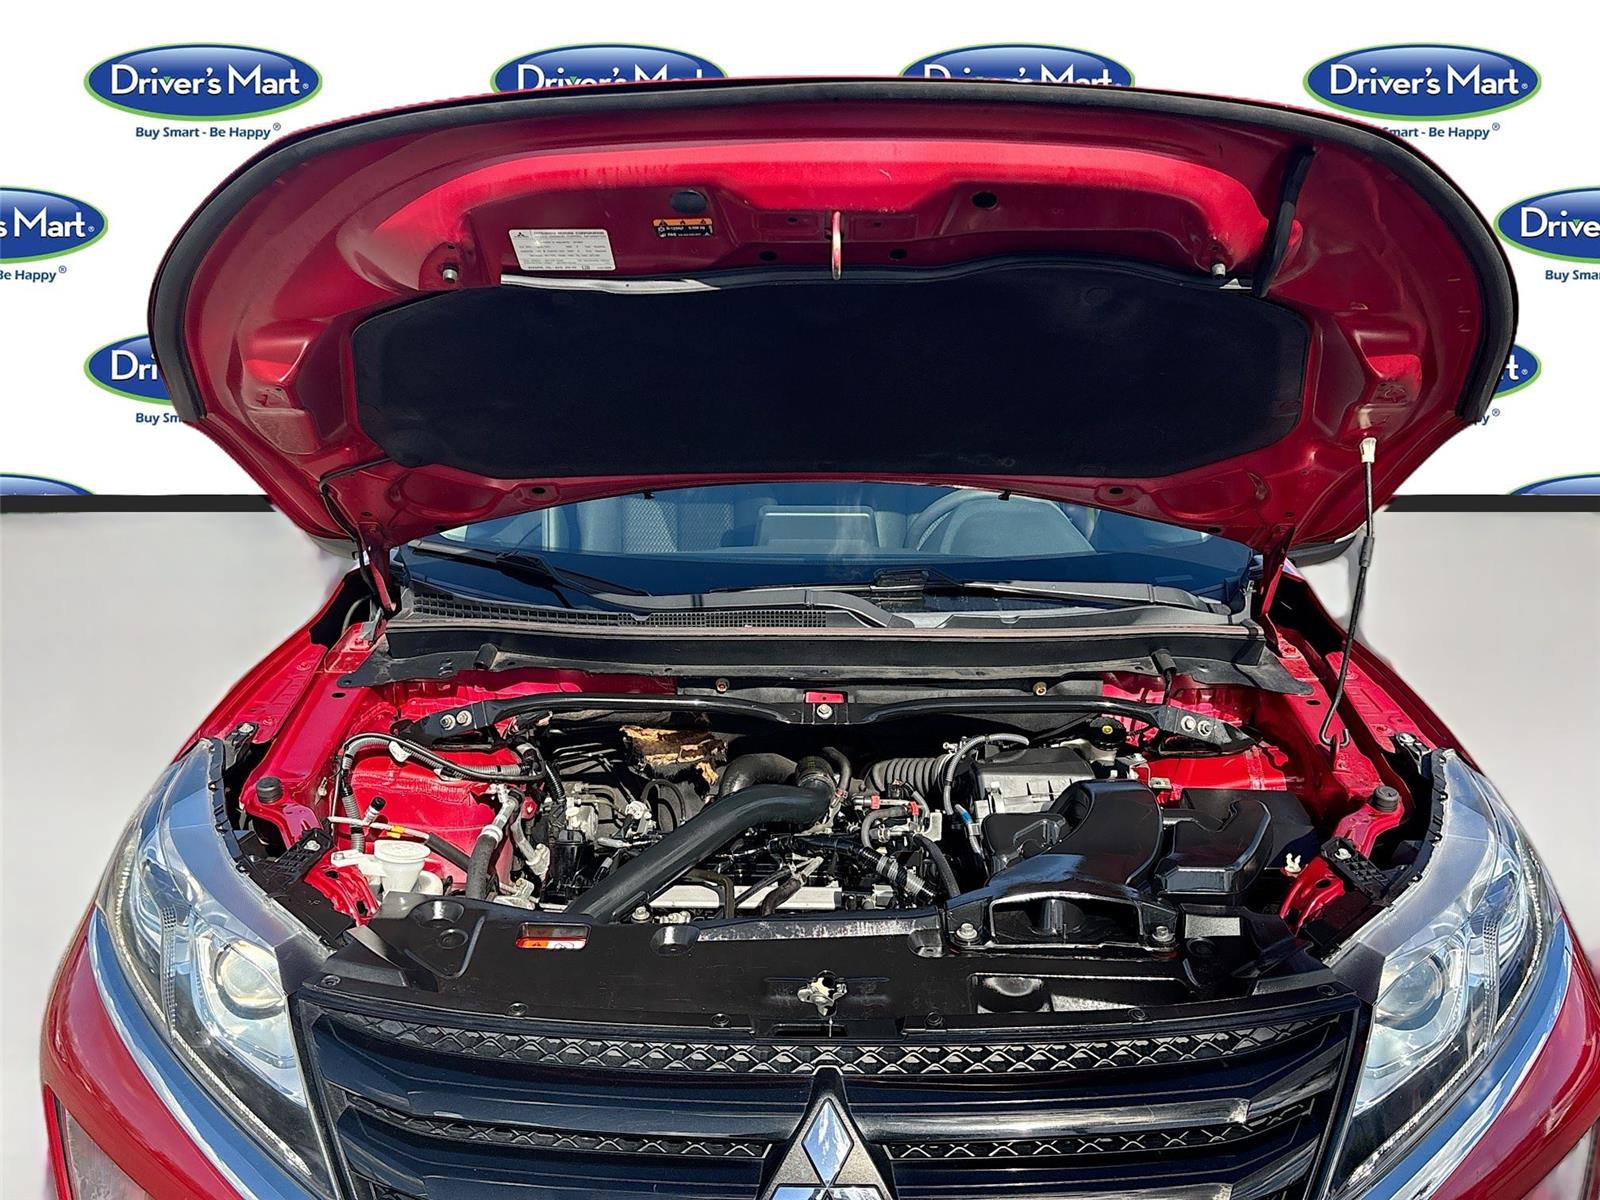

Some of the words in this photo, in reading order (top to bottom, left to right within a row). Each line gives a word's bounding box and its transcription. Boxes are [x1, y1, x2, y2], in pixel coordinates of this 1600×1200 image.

[111, 63, 222, 95] Driver's
[1330, 63, 1441, 95] Driver's
[135, 127, 160, 140] Buy
[163, 127, 200, 138] Smart
[209, 127, 226, 138] Be
[1428, 126, 1445, 137] Be
[1545, 270, 1570, 283] Buy
[1572, 270, 1600, 280] Sma
[136, 412, 160, 426] Buy
